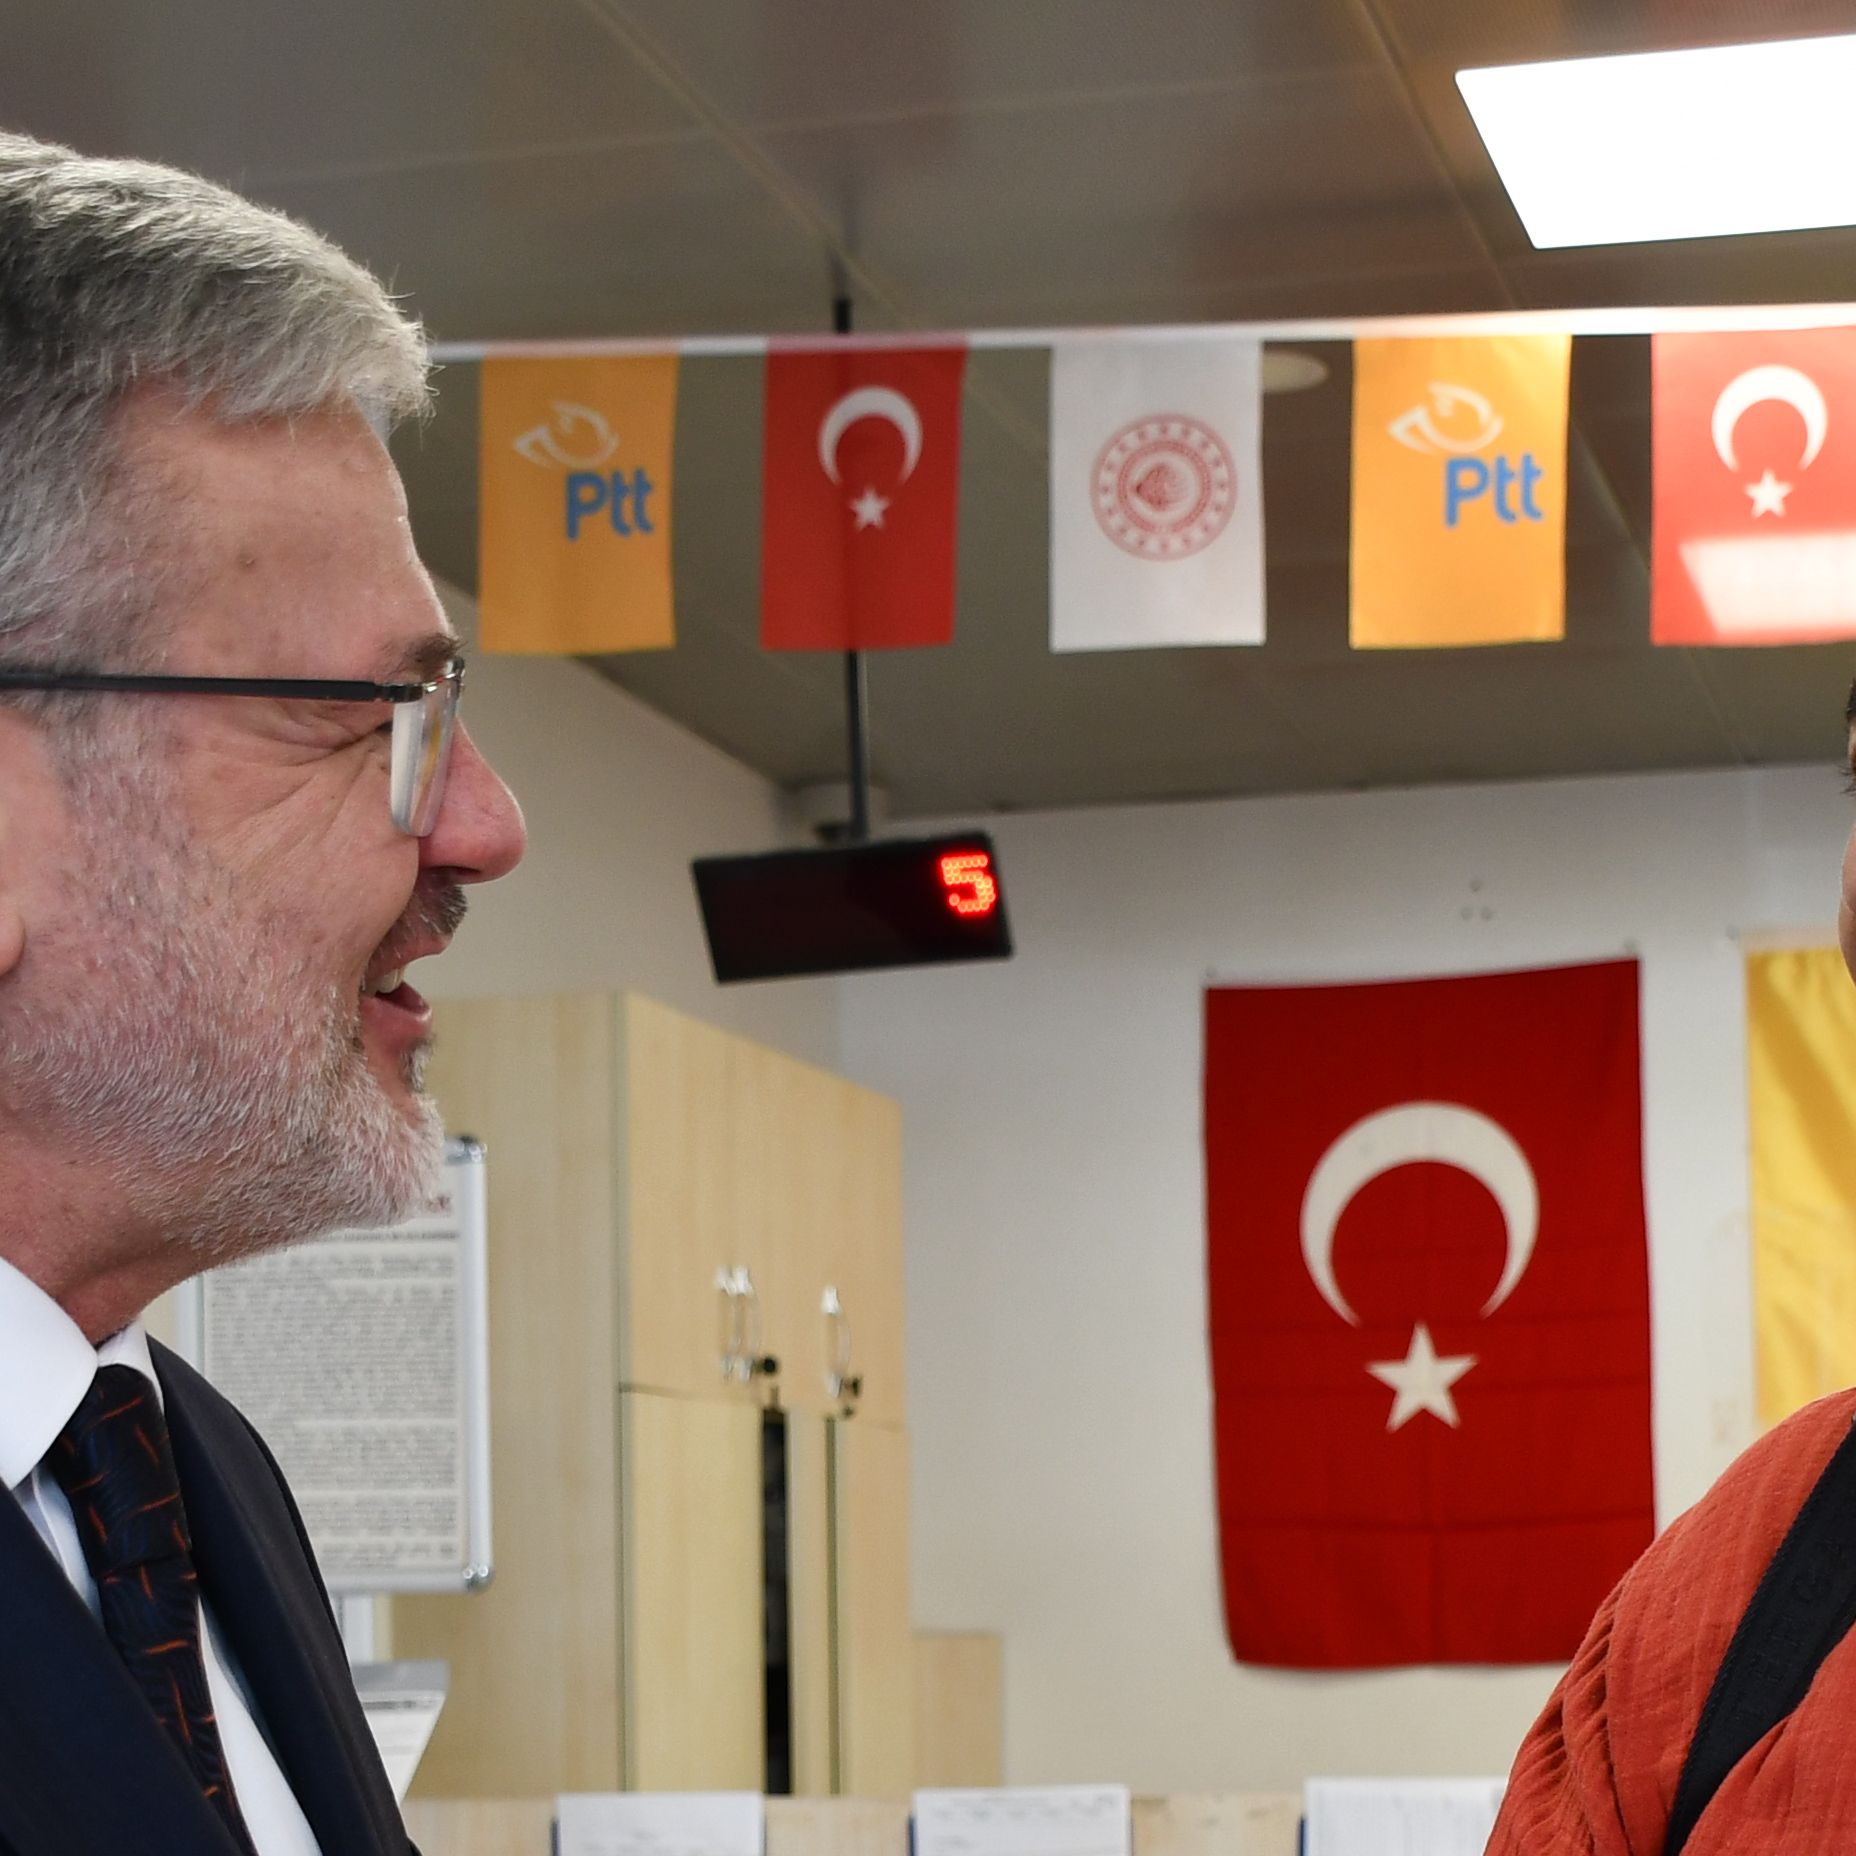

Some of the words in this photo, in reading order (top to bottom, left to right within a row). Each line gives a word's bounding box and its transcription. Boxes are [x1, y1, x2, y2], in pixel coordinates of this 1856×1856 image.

[567, 468, 652, 540] Ptt
[1446, 453, 1542, 527] Ptt
[942, 852, 996, 914] 5
